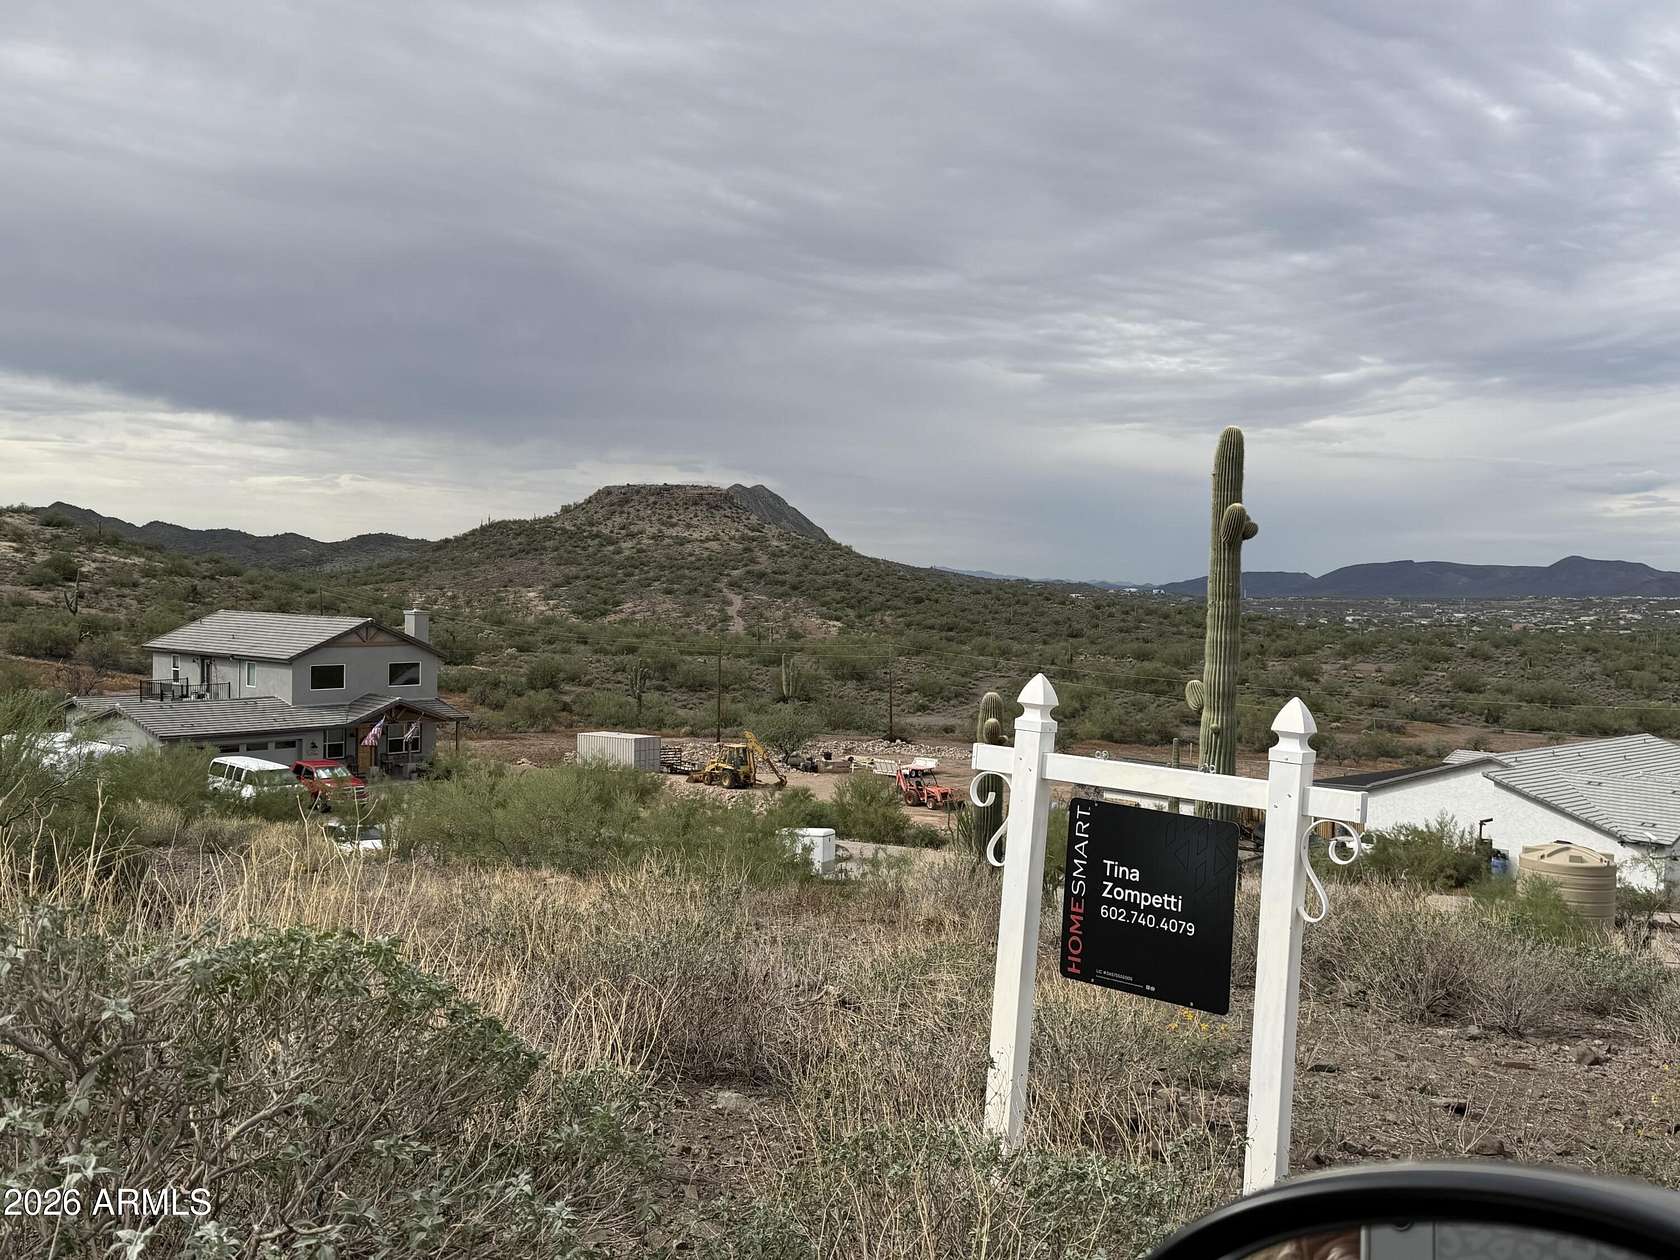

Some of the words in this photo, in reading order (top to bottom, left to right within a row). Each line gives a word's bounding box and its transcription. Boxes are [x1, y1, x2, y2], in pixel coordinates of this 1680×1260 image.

[1103, 859, 1140, 882] Tina
[1101, 881, 1183, 912] Zompetti
[1100, 905, 1195, 936] 602.740.4079
